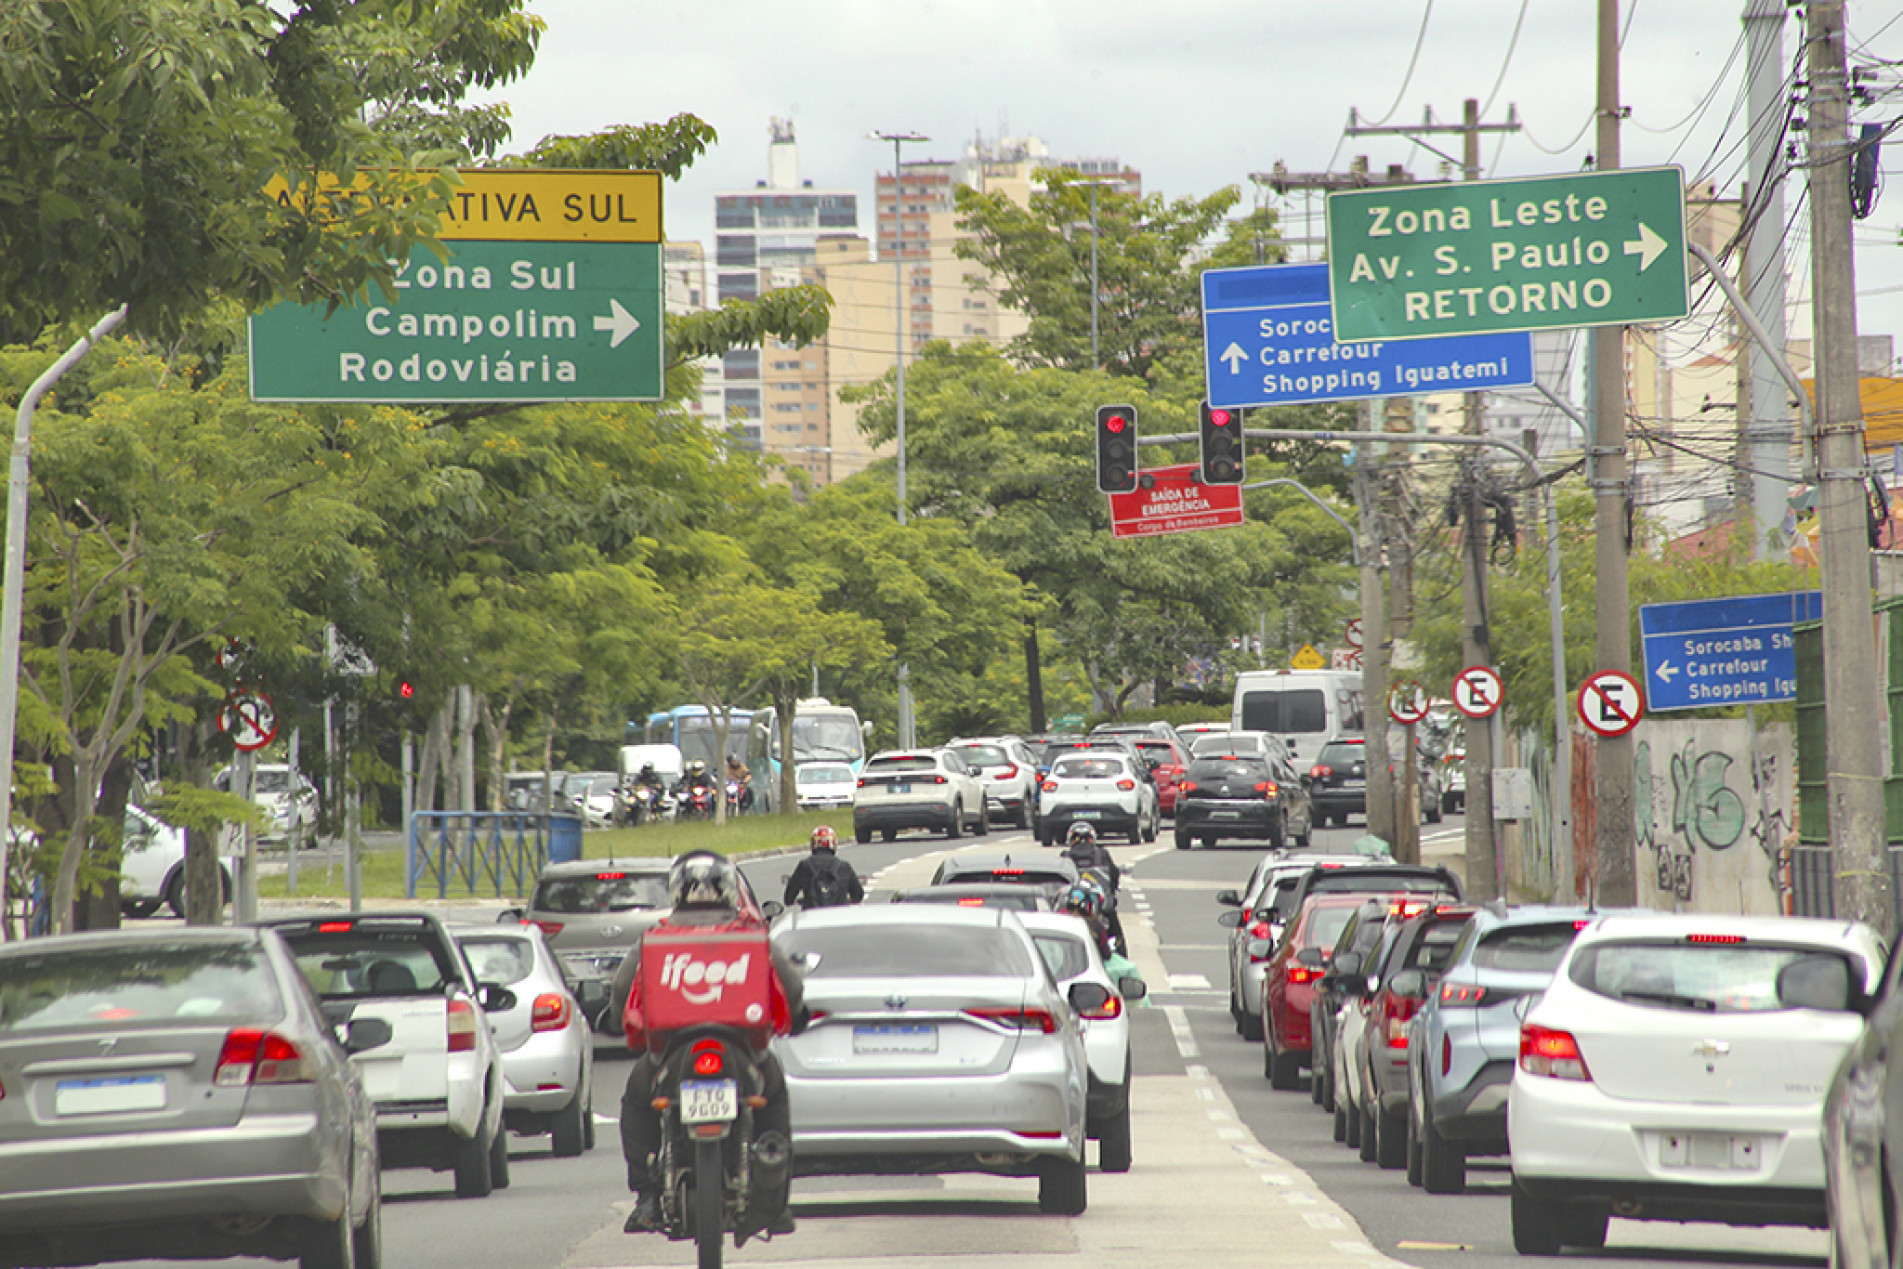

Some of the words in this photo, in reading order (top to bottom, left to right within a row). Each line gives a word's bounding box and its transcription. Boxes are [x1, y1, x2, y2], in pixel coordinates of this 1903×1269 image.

[564, 193, 637, 223] SUL
[1368, 205, 1471, 237] Zona
[1490, 193, 1609, 228] Leste
[386, 258, 491, 289] Zona
[510, 260, 576, 290] Sul
[1348, 251, 1413, 283] Av.
[1435, 246, 1471, 275] S.
[1491, 236, 1610, 271] Paulo
[1404, 278, 1612, 321] RETORNO
[365, 307, 577, 344] Campolim
[340, 350, 577, 382] Rodoviária
[1260, 342, 1383, 366] Carrefour
[1263, 369, 1381, 394] Shopping
[1396, 358, 1508, 387] Iguatemi
[1151, 485, 1183, 502] SAÍDA
[1184, 486, 1199, 498] DE
[1684, 635, 1762, 656] Sorocaba
[1771, 633, 1795, 649] Sh
[1686, 658, 1768, 677] Carrefour
[1688, 680, 1768, 699] Shopping
